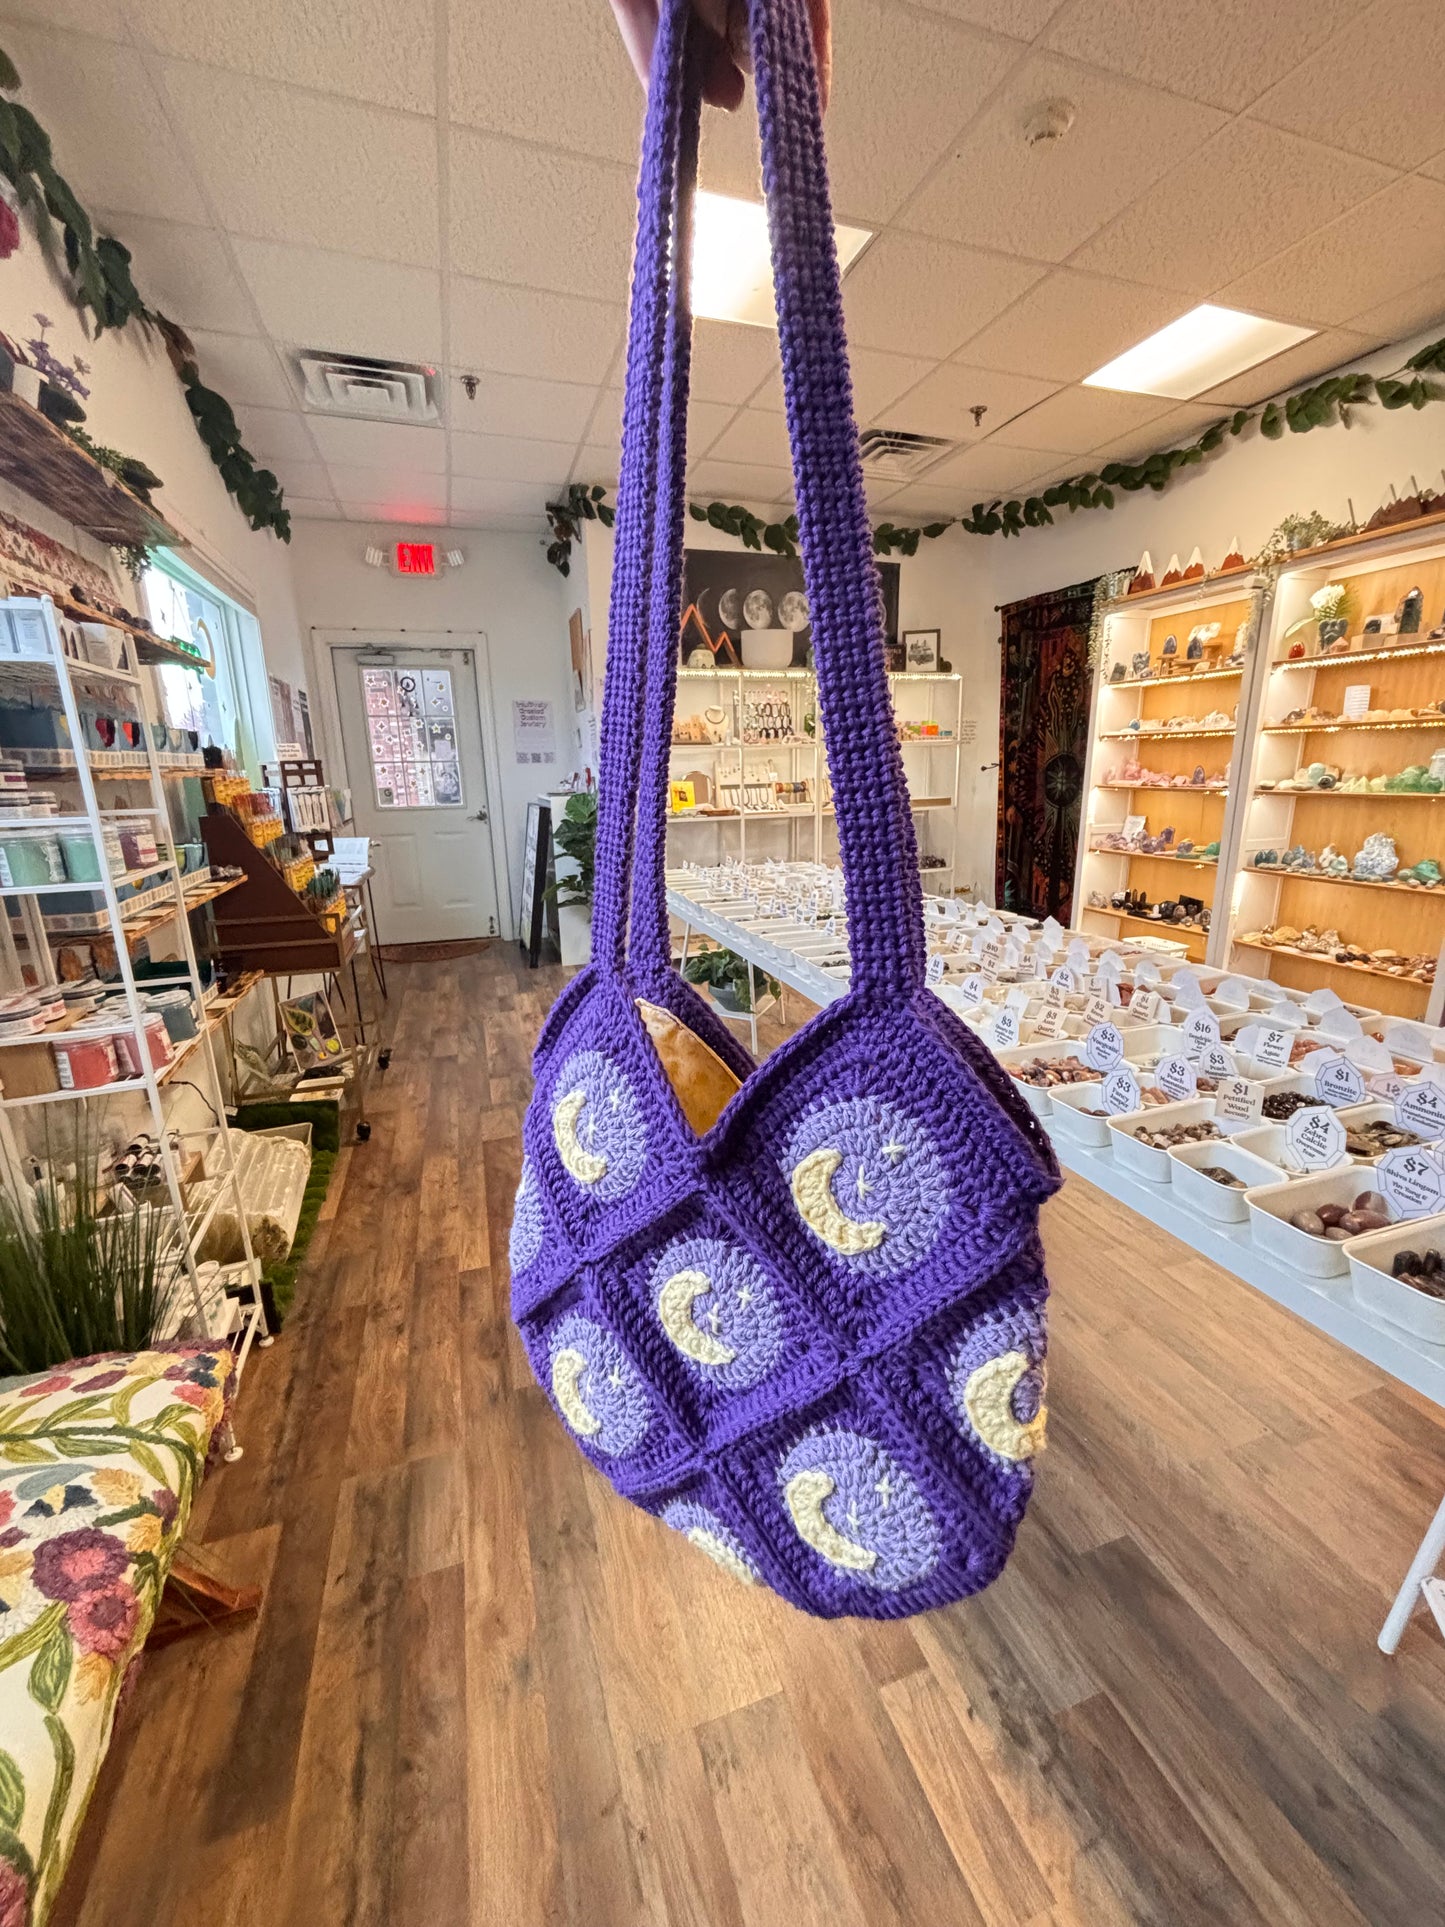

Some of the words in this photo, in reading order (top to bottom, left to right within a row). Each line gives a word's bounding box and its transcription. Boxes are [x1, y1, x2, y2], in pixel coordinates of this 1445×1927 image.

[397, 543, 434, 574] EXIT
[1194, 1020, 1211, 1034] $16
[1100, 1028, 1115, 1043] $3
[1267, 1031, 1284, 1043] $7
[1209, 1052, 1225, 1065] $3
[1169, 1061, 1186, 1077] $3
[1334, 1068, 1350, 1082] $1
[1116, 1077, 1132, 1093] $3
[1232, 1081, 1249, 1096] $1
[1324, 1080, 1358, 1096] Bronzite
[1227, 1102, 1249, 1113] Wood
[1416, 1091, 1438, 1109] $4
[1309, 1115, 1330, 1135] $4
[1301, 1133, 1327, 1150] Calcite
[1303, 1126, 1327, 1143] Zebra
[1403, 1157, 1429, 1176] $7
[1386, 1168, 1407, 1182] Shiva
[1408, 1177, 1440, 1196] Lingam
